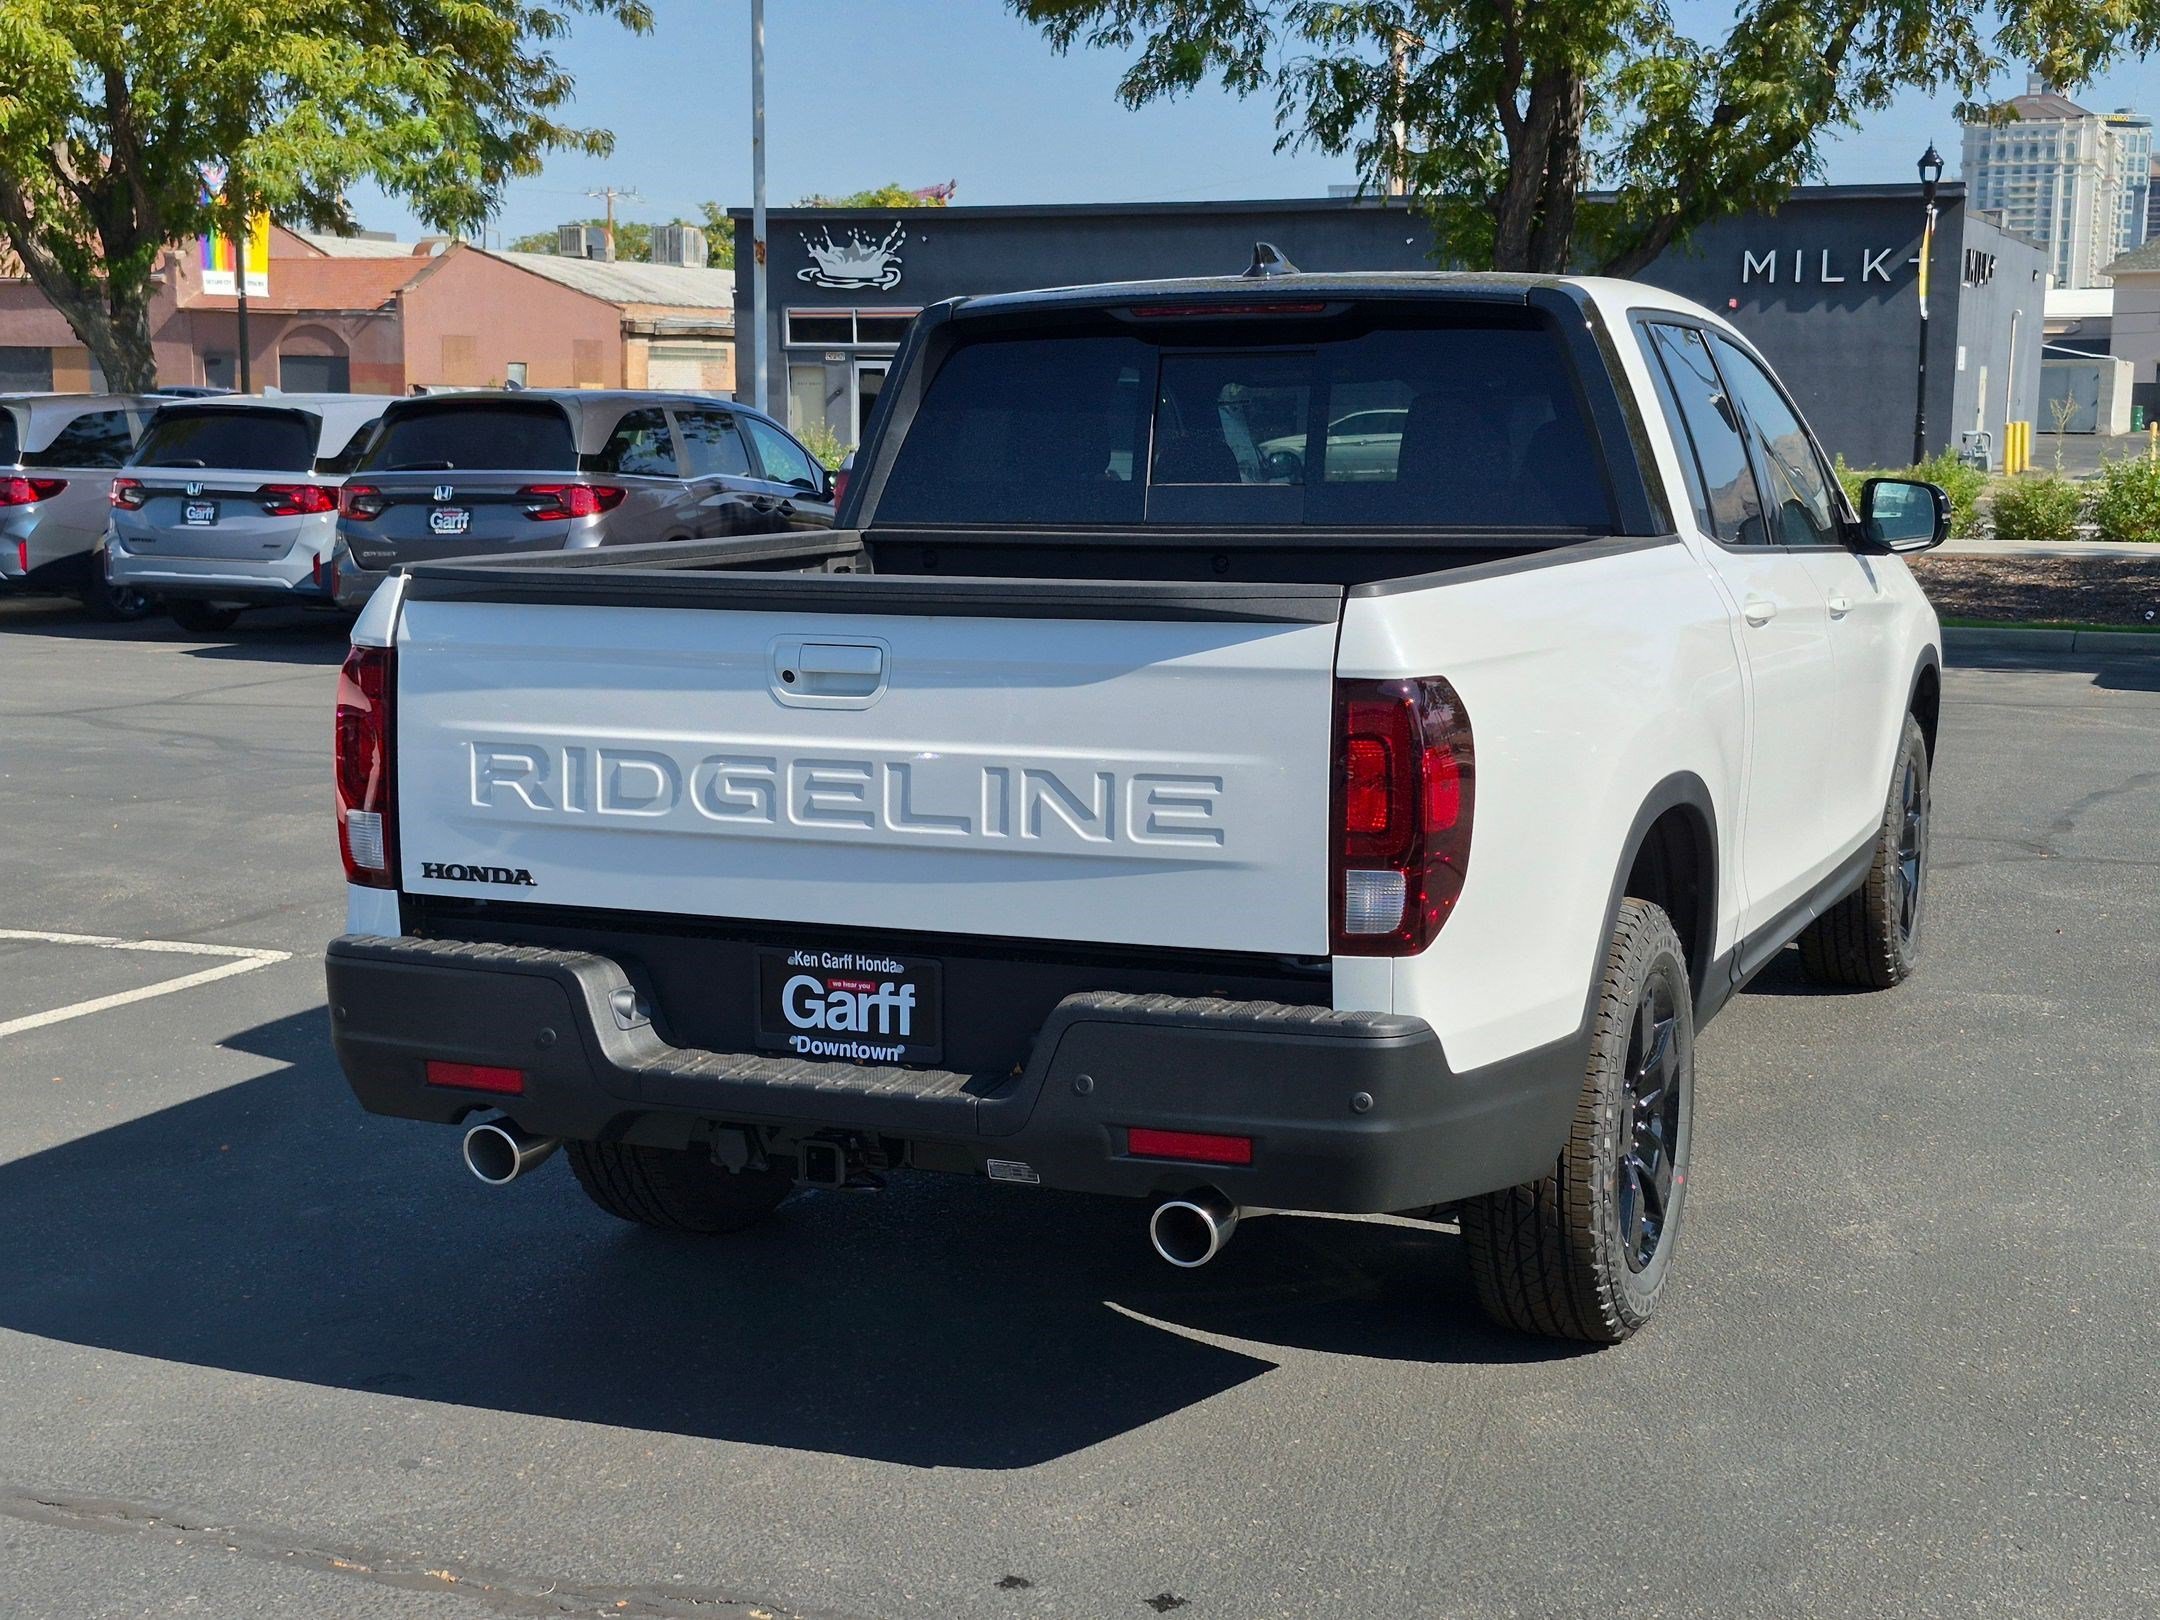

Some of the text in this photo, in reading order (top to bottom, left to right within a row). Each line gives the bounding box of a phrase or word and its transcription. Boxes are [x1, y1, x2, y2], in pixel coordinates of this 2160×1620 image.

[186, 506, 215, 520] Garff
[430, 512, 470, 529] Garff
[470, 741, 1225, 848] RIDGELINE
[421, 862, 538, 886] HONDA
[794, 950, 899, 973] Ken Garff Honda
[782, 974, 916, 1036] Garff
[796, 1035, 900, 1061] Downtown
